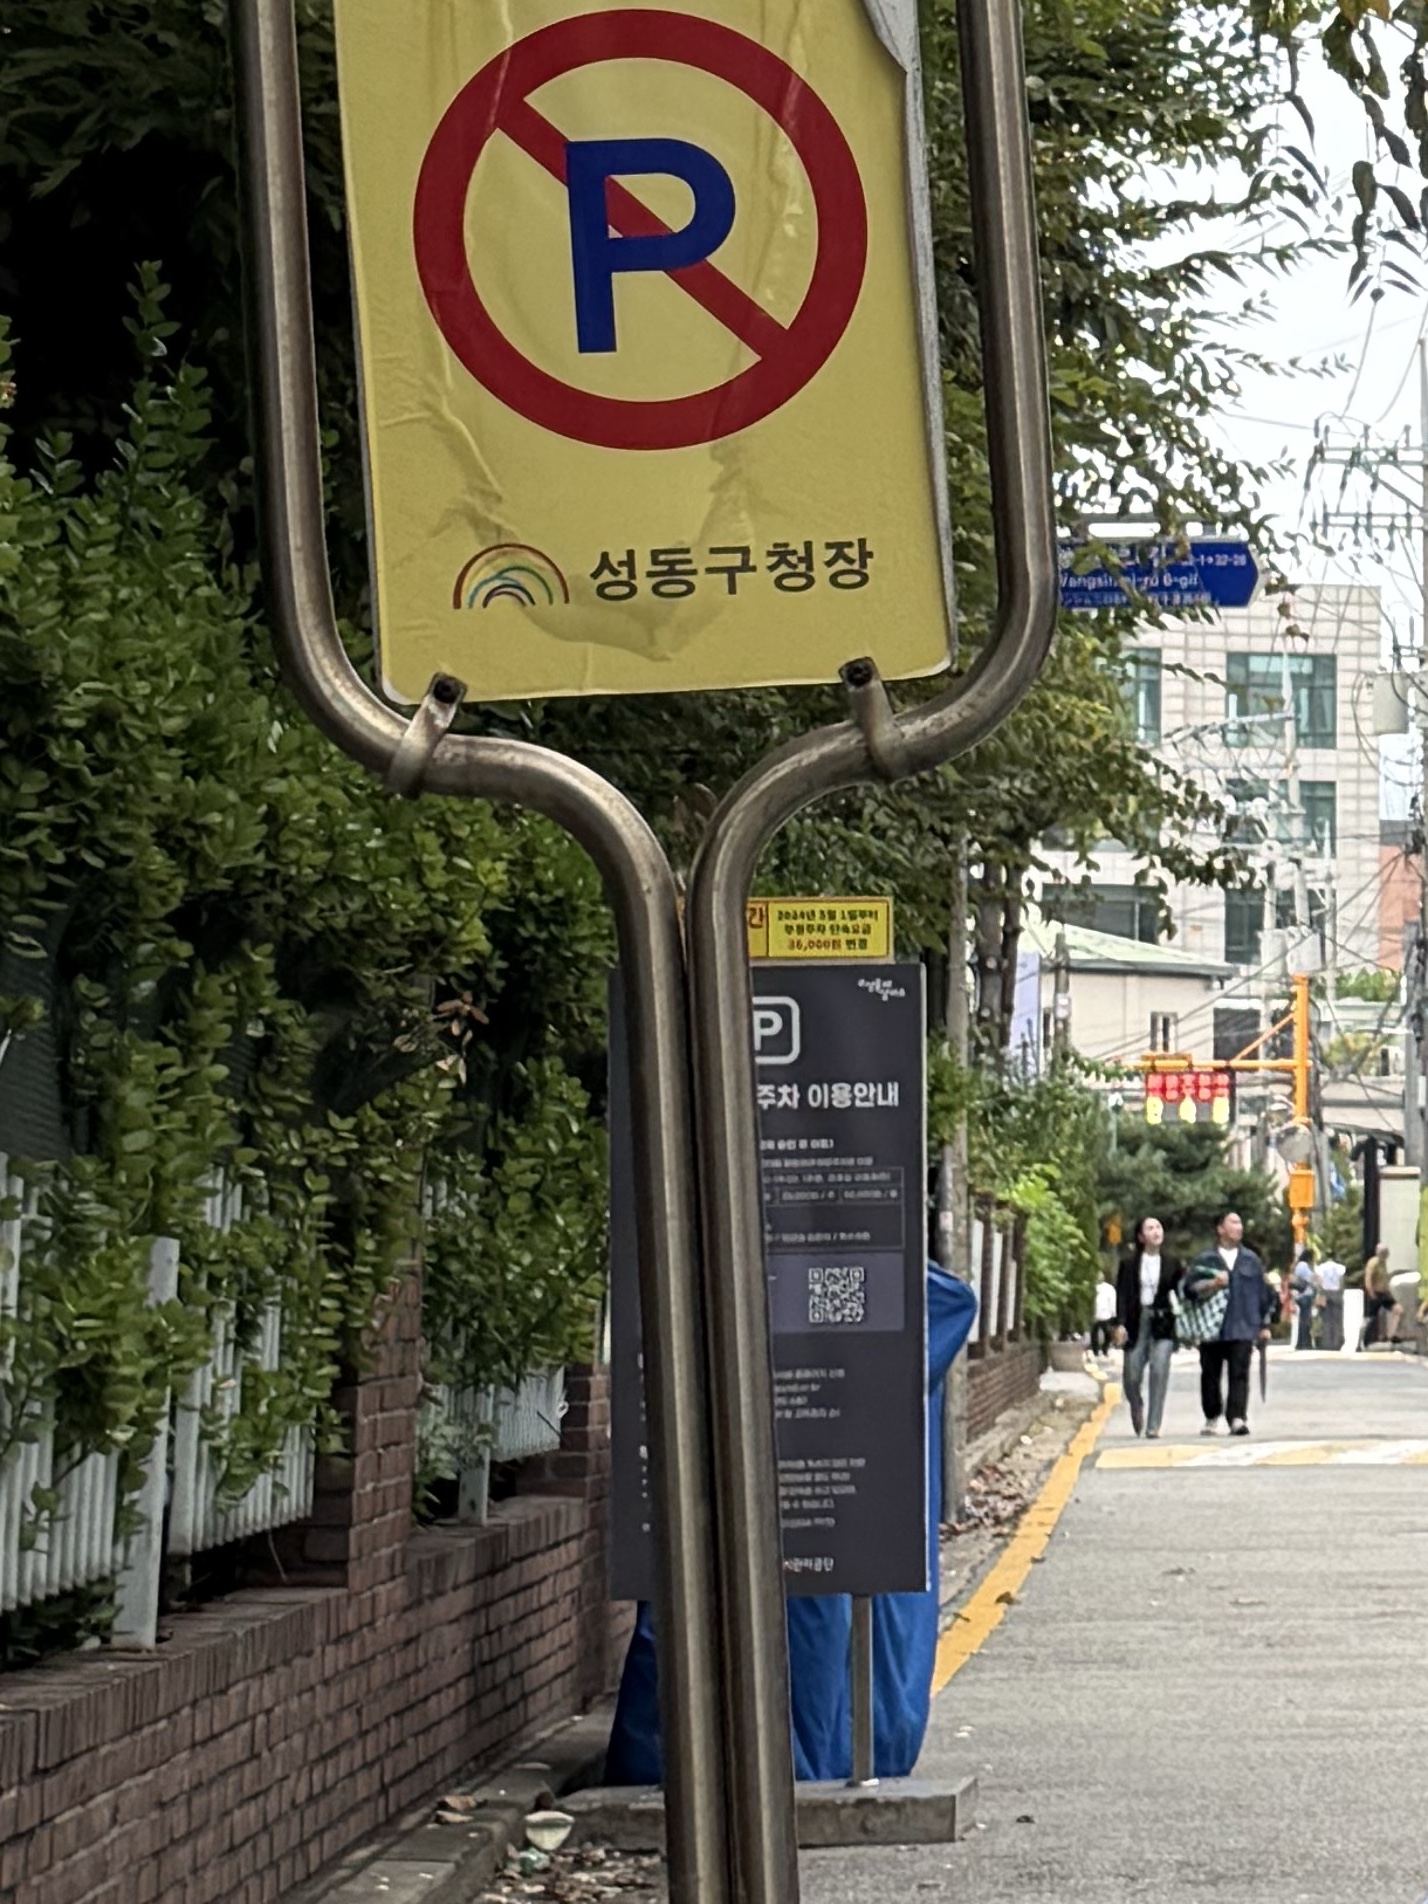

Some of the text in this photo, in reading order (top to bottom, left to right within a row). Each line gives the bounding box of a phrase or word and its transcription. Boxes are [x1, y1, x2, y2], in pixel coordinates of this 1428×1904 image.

[565, 137, 736, 354] P
[589, 537, 875, 602] 성동구청장
[753, 1010, 783, 1052] P
[757, 1081, 900, 1111] 주차 이용안내
